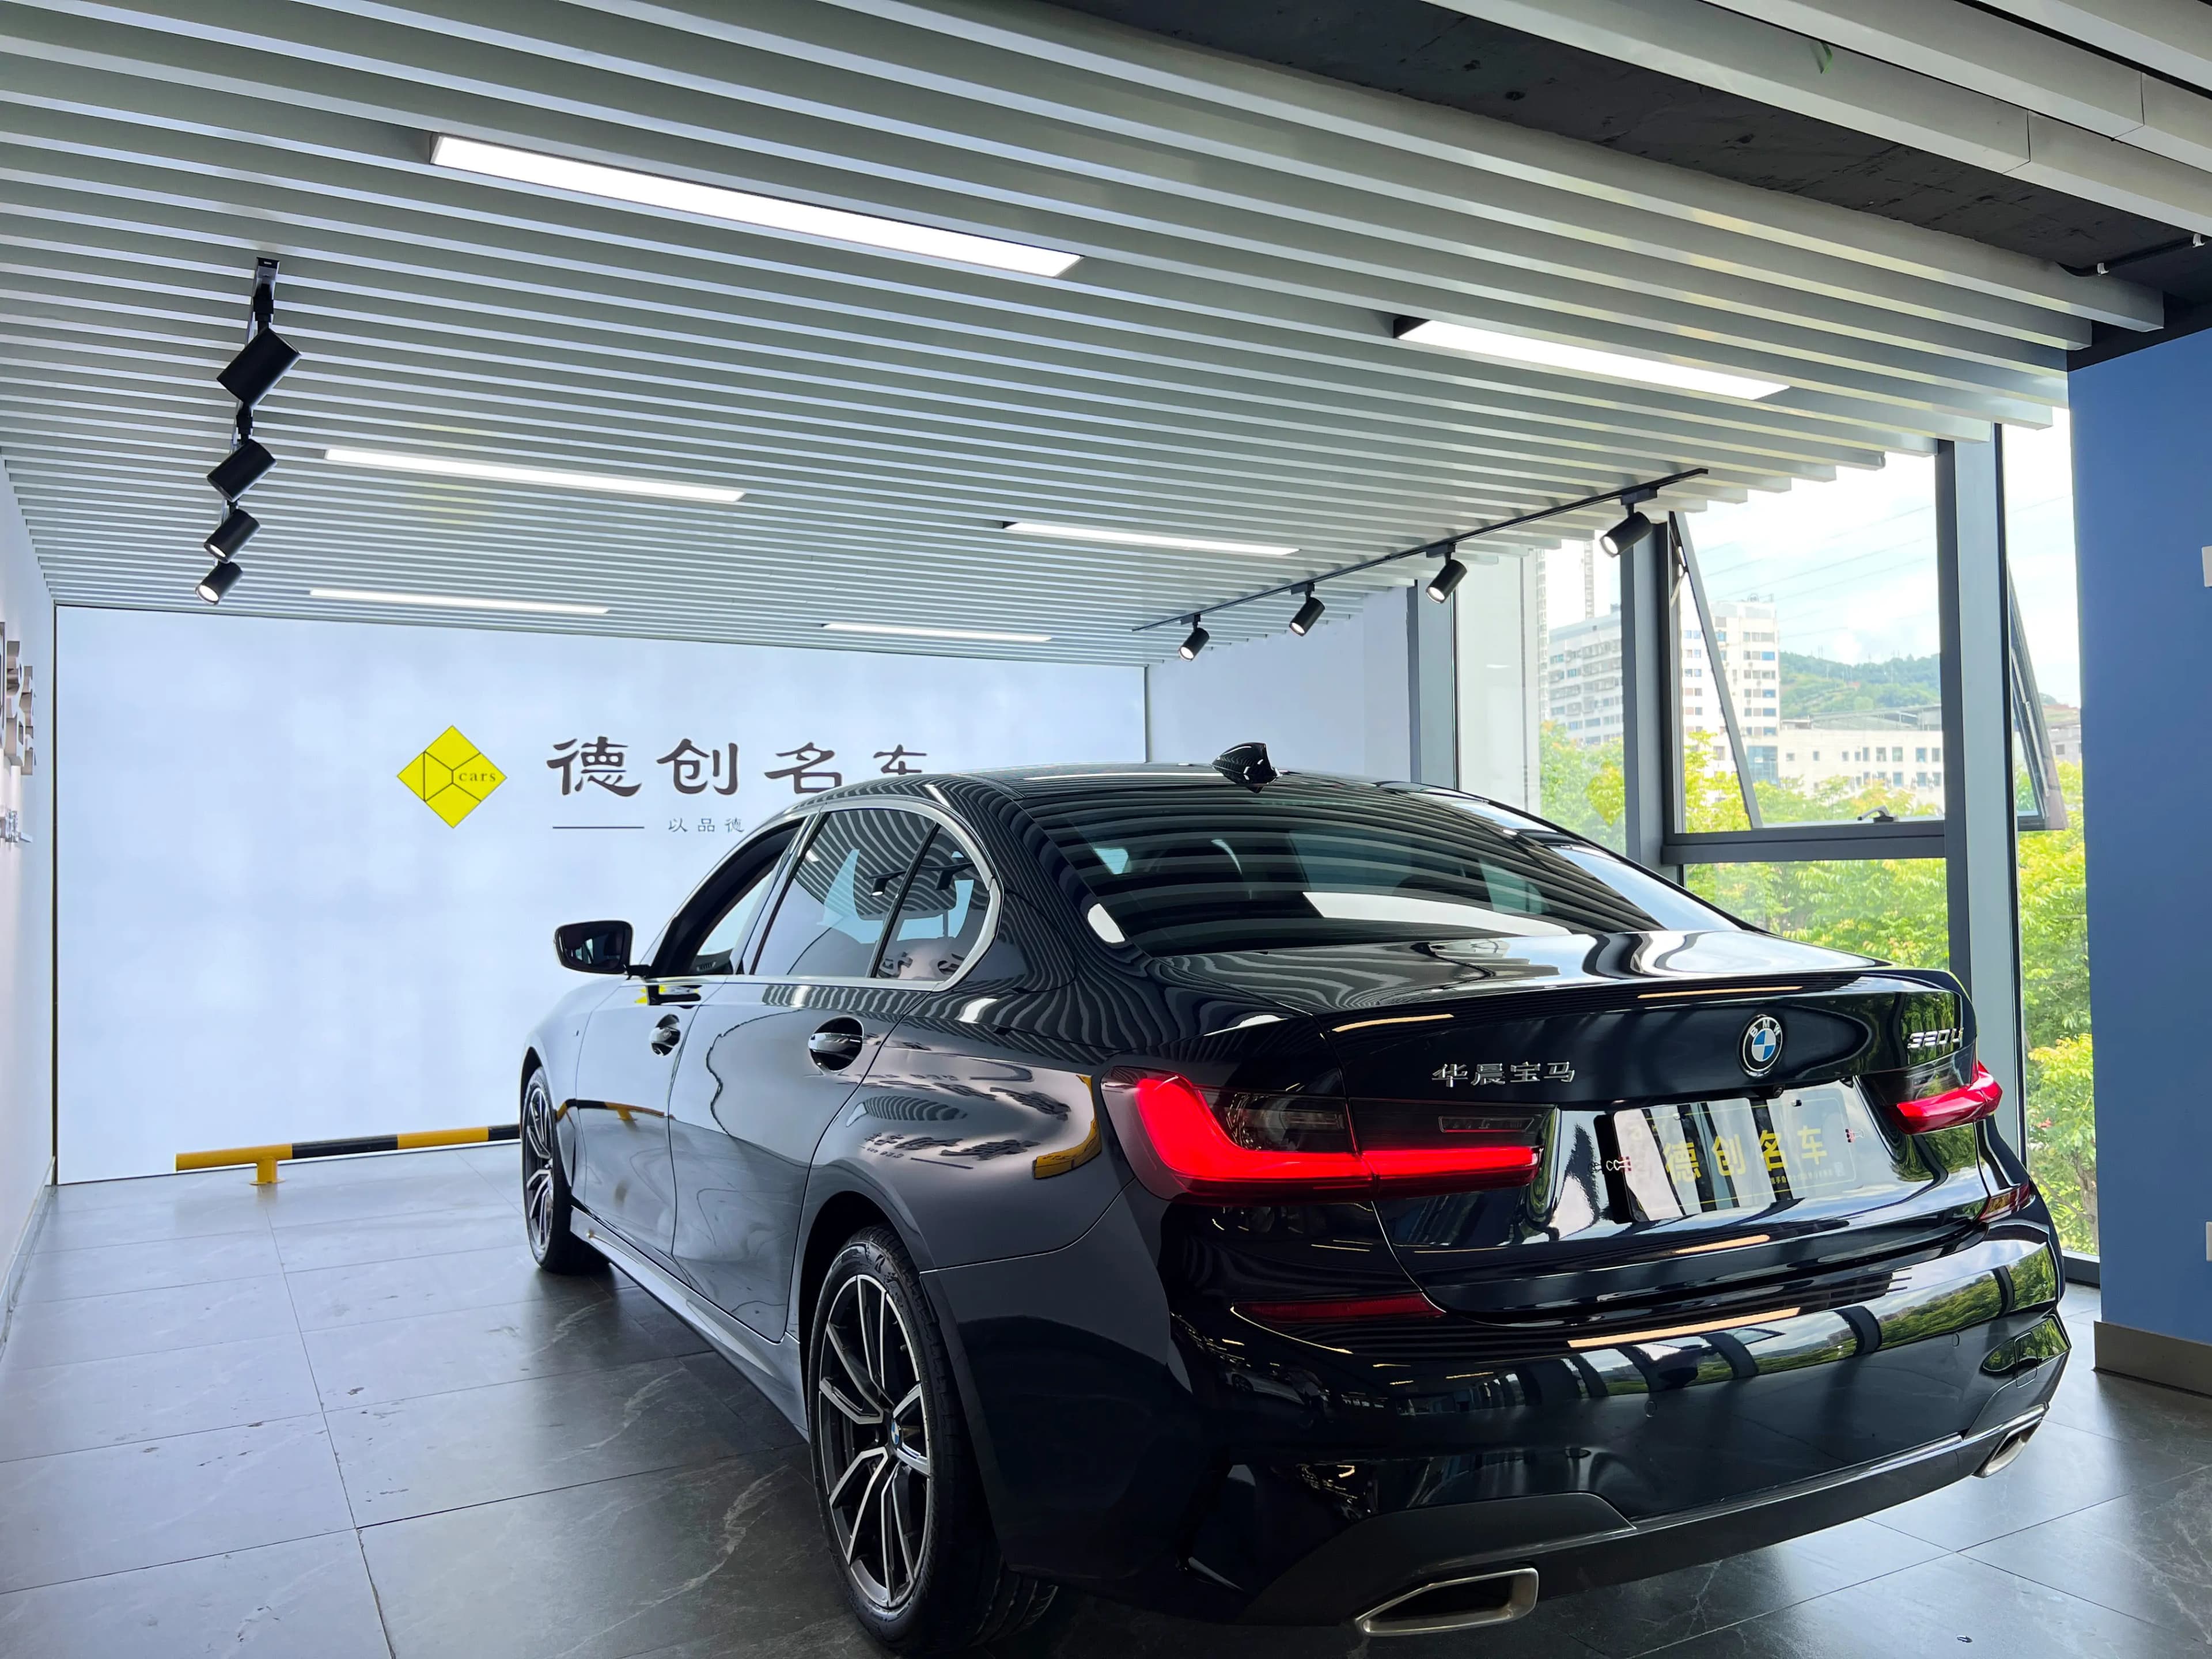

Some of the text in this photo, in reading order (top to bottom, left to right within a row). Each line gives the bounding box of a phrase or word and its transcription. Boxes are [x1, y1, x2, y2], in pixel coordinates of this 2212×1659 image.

[459, 772, 495, 782] cars
[547, 736, 927, 797] 德创名车
[668, 817, 745, 833] 以品德
[1750, 1018, 1781, 1037] BMW
[1431, 1062, 1575, 1088] 华晨宝马
[1662, 1126, 1827, 1184] 德创名车
